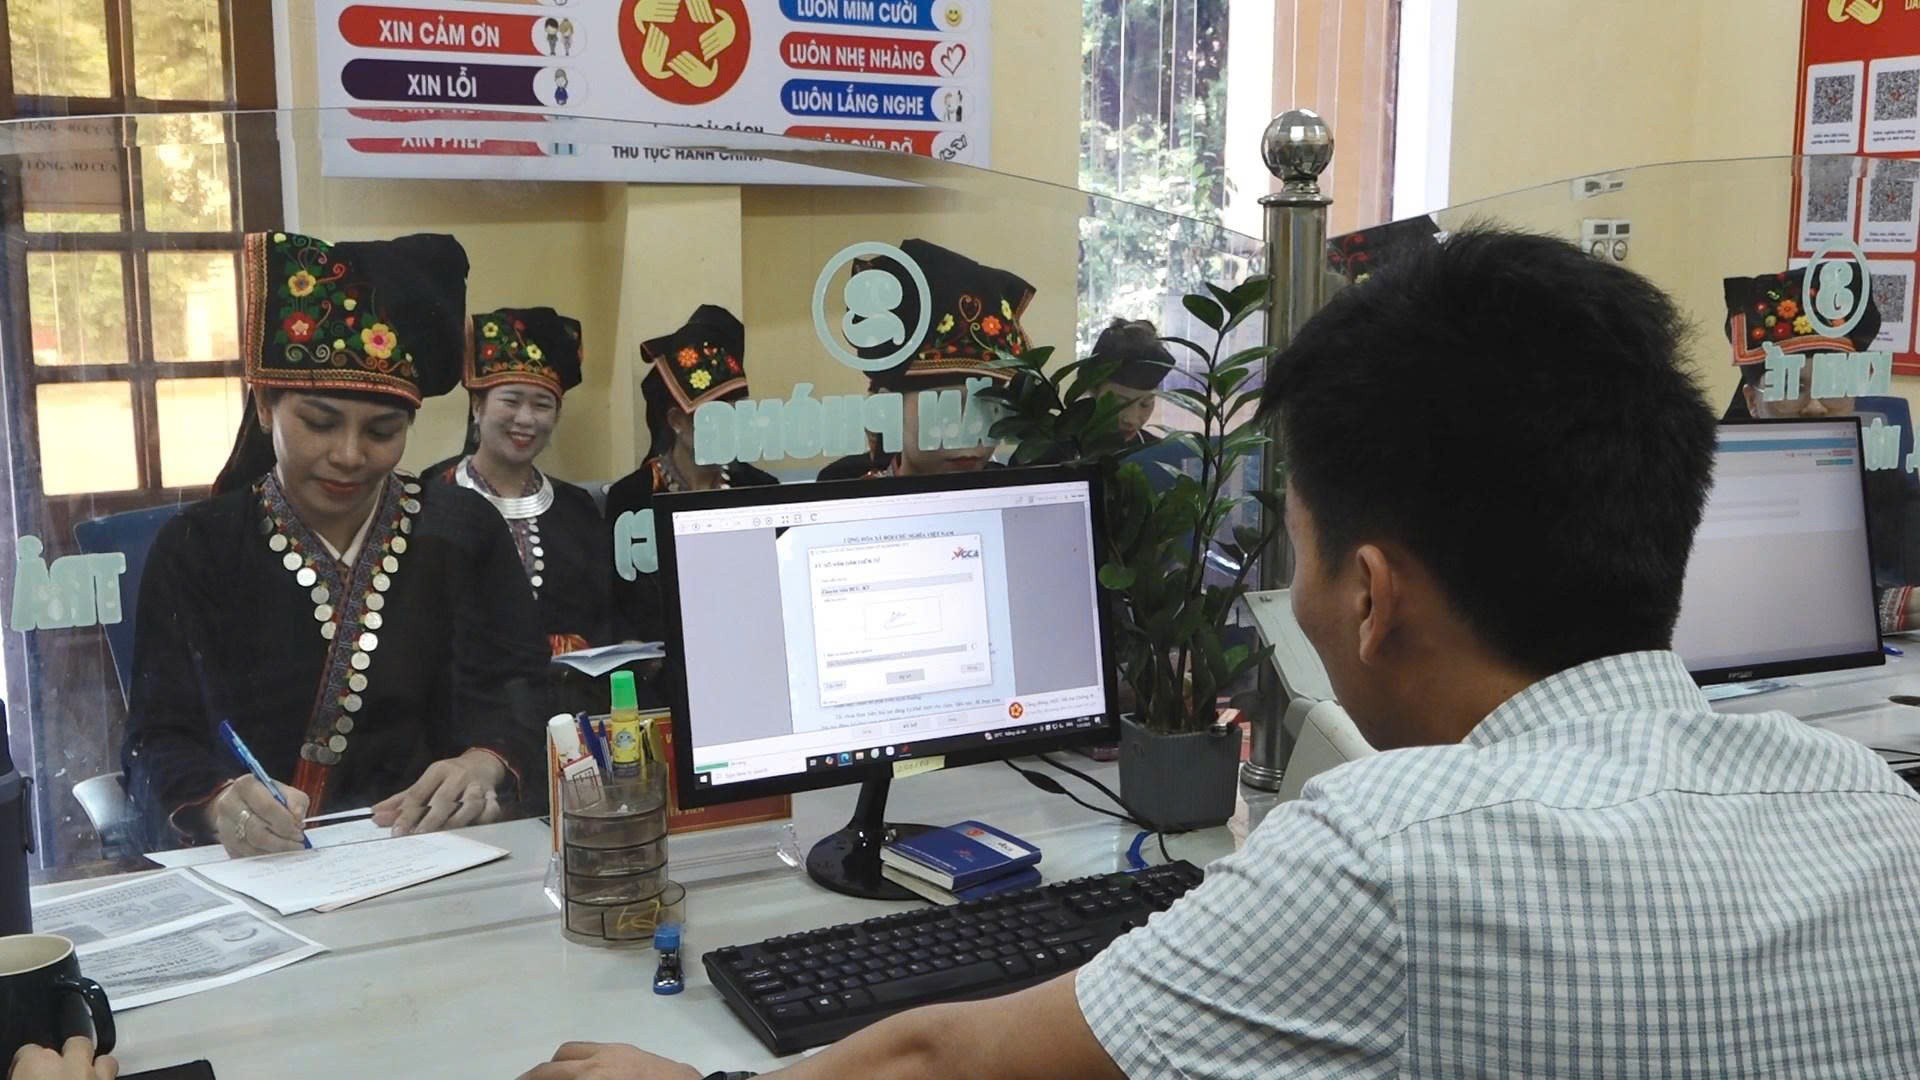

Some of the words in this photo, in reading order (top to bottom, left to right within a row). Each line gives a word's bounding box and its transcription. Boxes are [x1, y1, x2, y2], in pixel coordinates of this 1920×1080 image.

[379, 19, 413, 43] XIN
[419, 16, 465, 46] CẢM
[471, 24, 500, 48] ƠN
[789, 39, 831, 65] LUÔN
[836, 46, 865, 72] NHẸ
[870, 45, 925, 70] NHÀNG
[408, 74, 441, 97] XIN
[447, 66, 477, 98] LỖI
[792, 86, 832, 112] LUÔN
[837, 84, 878, 115] LẮNG
[883, 95, 924, 116] NGHE
[644, 147, 671, 163] TỤC
